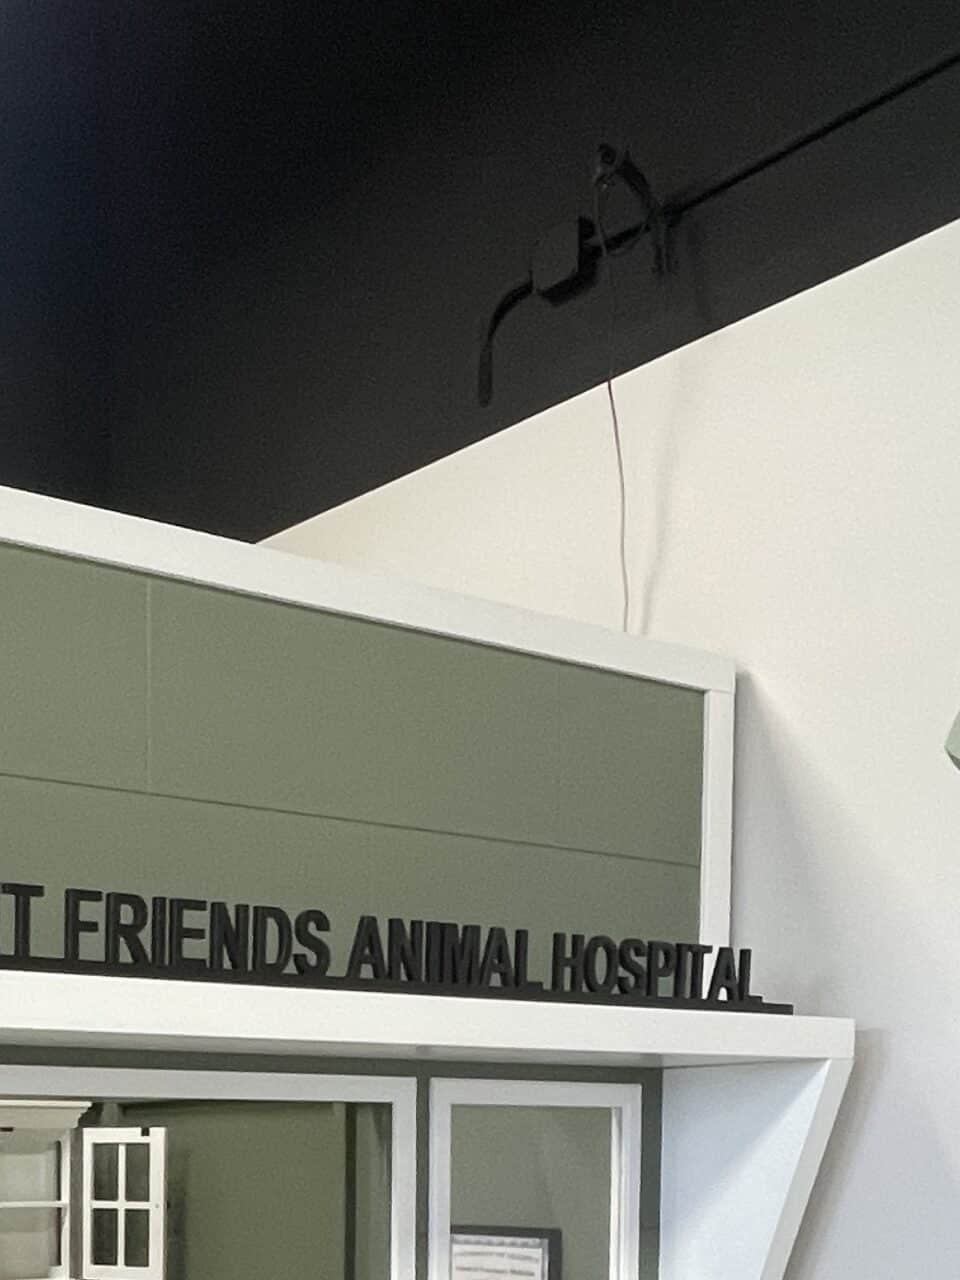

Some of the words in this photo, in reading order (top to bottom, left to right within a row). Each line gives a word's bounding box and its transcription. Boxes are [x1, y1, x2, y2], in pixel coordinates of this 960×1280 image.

[64, 887, 331, 977] FRIENDS
[344, 915, 544, 988] ANIMAL
[552, 931, 764, 1004] HOSPITAL
